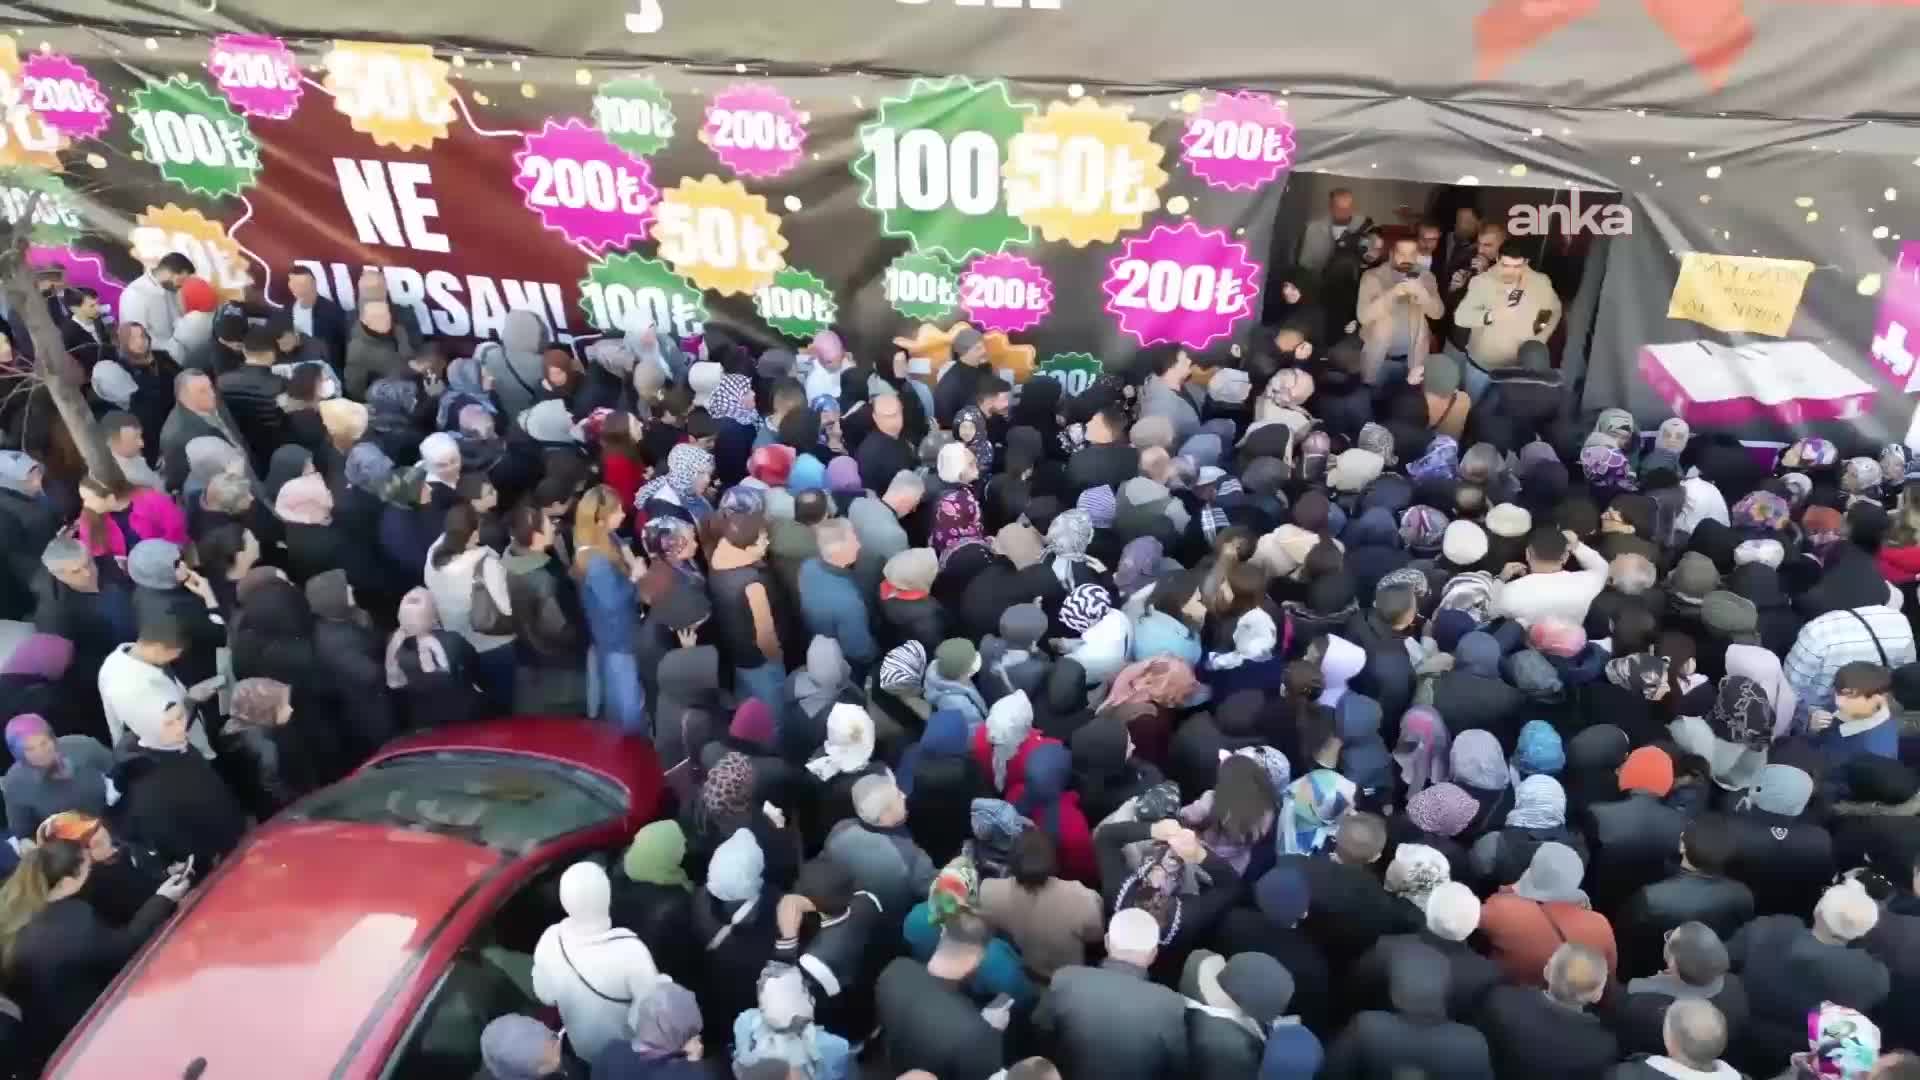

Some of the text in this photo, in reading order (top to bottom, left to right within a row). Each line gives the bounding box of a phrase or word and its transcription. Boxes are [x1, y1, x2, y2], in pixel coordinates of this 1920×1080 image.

[135, 110, 258, 168] 100₺
[710, 109, 799, 150] 200₺
[1189, 119, 1286, 162] 200₺
[523, 155, 649, 214] 200₺
[1005, 132, 1158, 215] 50₺
[332, 157, 450, 252] NE
[660, 202, 783, 272] 50₺
[758, 285, 834, 324] 100₺
[965, 273, 1045, 310] 200₺
[1114, 259, 1245, 315] 200₺
